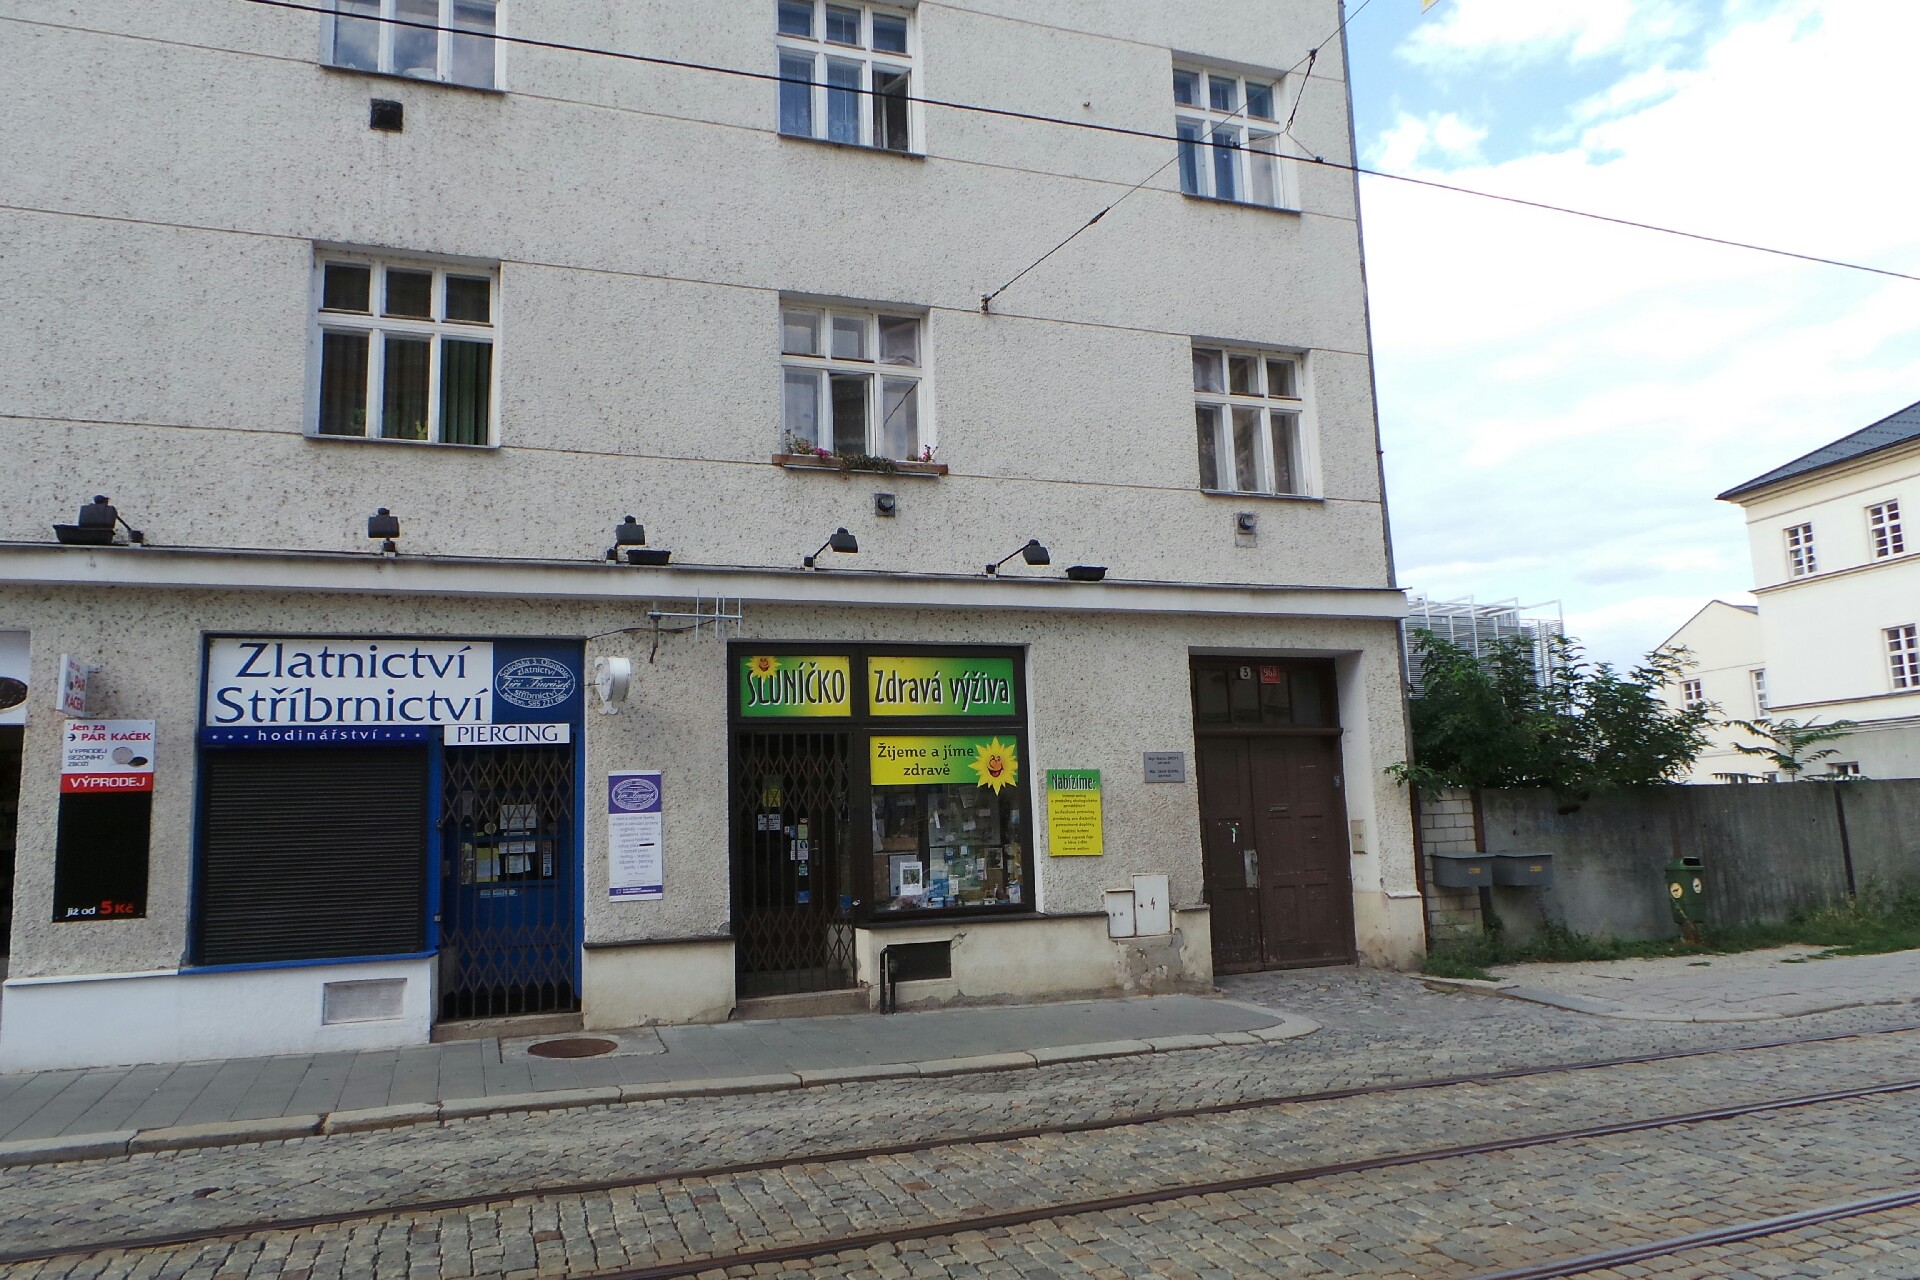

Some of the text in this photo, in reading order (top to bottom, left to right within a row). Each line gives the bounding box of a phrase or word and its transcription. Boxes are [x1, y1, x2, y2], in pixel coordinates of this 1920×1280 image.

[235, 642, 472, 679] Zlatnictví
[517, 666, 557, 676] zlatnictví
[1243, 667, 1248, 677] 3
[1263, 667, 1277, 677] 968
[747, 661, 846, 707] SLUNÍČKO
[874, 669, 1011, 712] Zdravá výživa
[214, 686, 489, 724] Stříbrnictví
[81, 731, 151, 740] PÁR KAČEK
[258, 729, 377, 741] hodinářství
[457, 725, 558, 742] PIERCING
[877, 743, 974, 761] Žijeme a jíme
[903, 764, 951, 776] zdravě
[70, 775, 145, 788] VÝPRODEJ
[1051, 773, 1097, 791] Nabízíme:
[65, 900, 134, 917] již od 5 Kč
